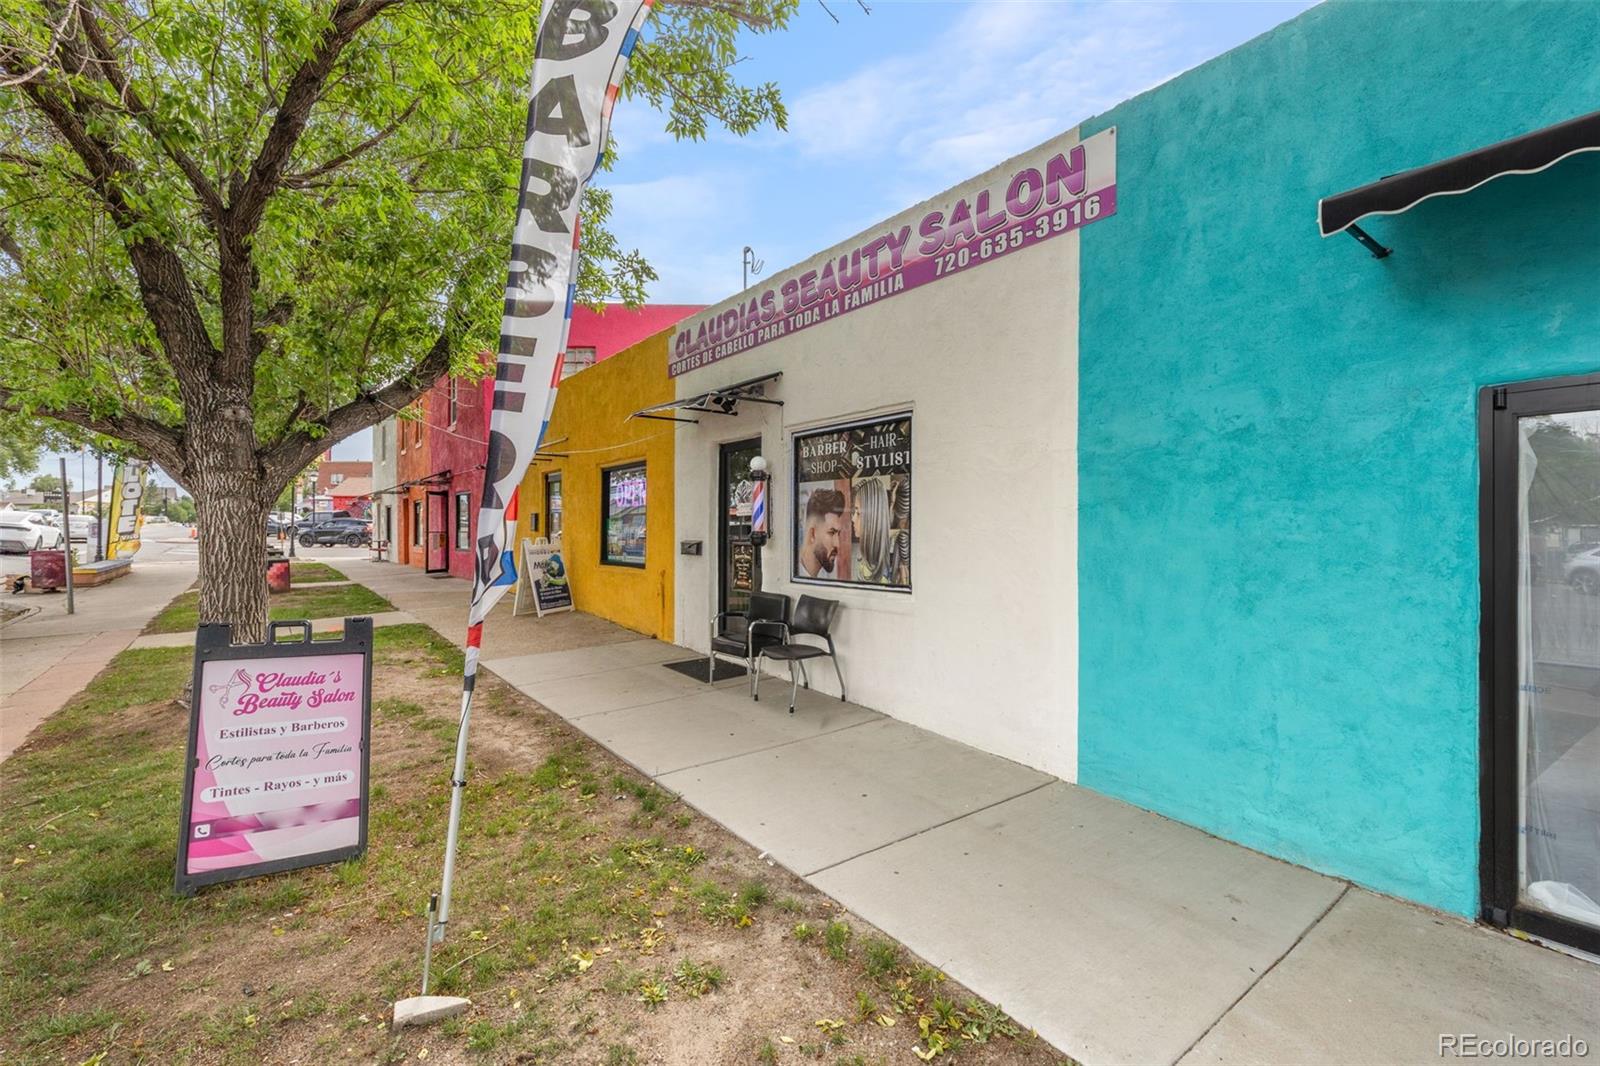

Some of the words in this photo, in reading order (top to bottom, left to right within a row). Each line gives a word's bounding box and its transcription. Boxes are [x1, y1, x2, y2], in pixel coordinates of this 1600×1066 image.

[935, 195, 1101, 276] 720-635-3916
[675, 290, 776, 358] CLAUDIAS
[781, 226, 912, 314] BEAUTY
[918, 144, 1088, 256] SALON
[671, 354, 701, 377] CORTES
[702, 350, 714, 364] DE
[715, 331, 755, 358] CABELLO
[758, 320, 785, 344] PARA
[789, 309, 821, 331] TODA
[824, 300, 840, 318] LA
[844, 273, 905, 310] FAMILIA
[802, 440, 847, 458] BARBER
[870, 432, 897, 449] HAIR
[810, 459, 838, 474] SHOP
[856, 451, 910, 469] STYLIST
[118, 457, 143, 534] LOTE
[233, 692, 303, 716] Beauty
[306, 689, 356, 708] Salon
[219, 726, 277, 739] Estilistas
[279, 727, 288, 735] y
[291, 720, 346, 733] Barberos
[205, 755, 250, 771] Cortes
[247, 756, 273, 768] para
[273, 751, 296, 760] toda
[298, 749, 308, 758] la
[312, 742, 353, 760] Familia
[210, 786, 251, 799] Tintes
[264, 781, 302, 792] Rayos
[313, 778, 321, 787] y
[324, 772, 348, 783] más
